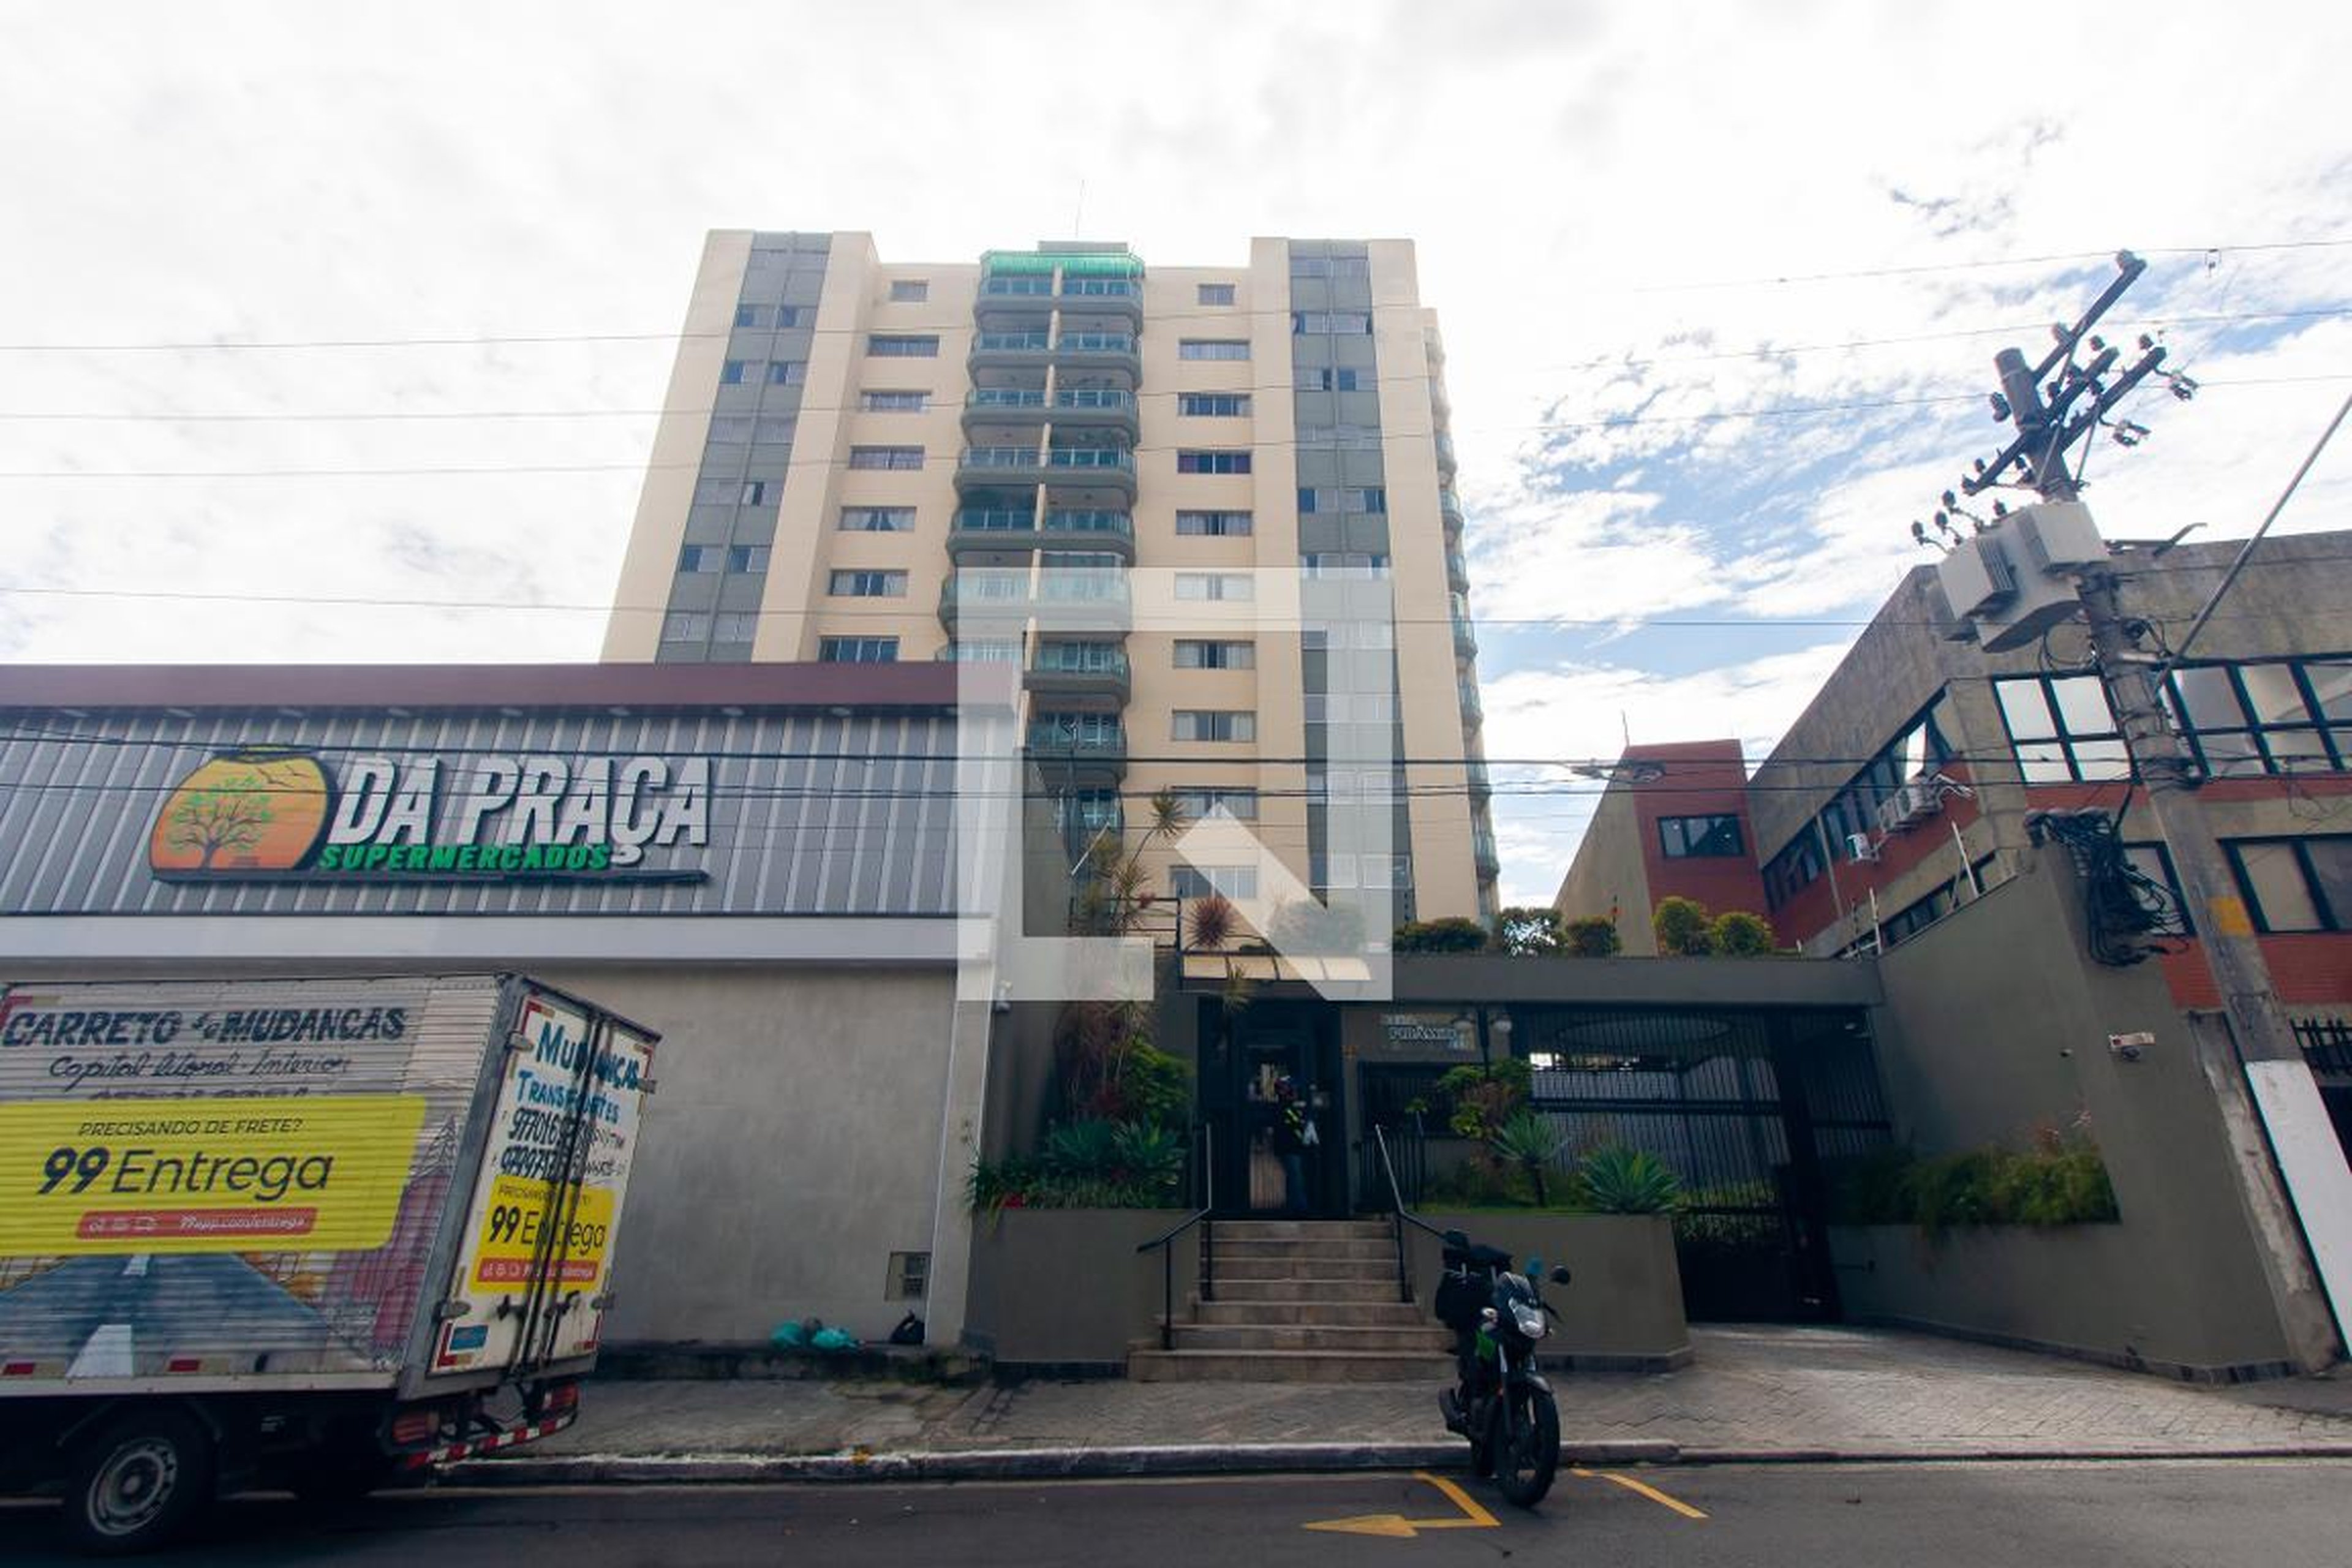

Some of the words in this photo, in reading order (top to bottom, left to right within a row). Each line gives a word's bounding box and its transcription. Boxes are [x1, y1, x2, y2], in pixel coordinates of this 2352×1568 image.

[327, 756, 441, 845] DA
[453, 756, 709, 865] PRAÇA
[318, 845, 612, 870] SUPERMERCADOS
[2, 1011, 182, 1046] CARRETO
[78, 1122, 199, 1137] PRECISANDO
[204, 1121, 230, 1134] DE
[234, 1118, 304, 1134] FRETE?
[37, 1147, 111, 1195] 99
[111, 1149, 334, 1202] Entrega
[489, 1205, 521, 1243] 99
